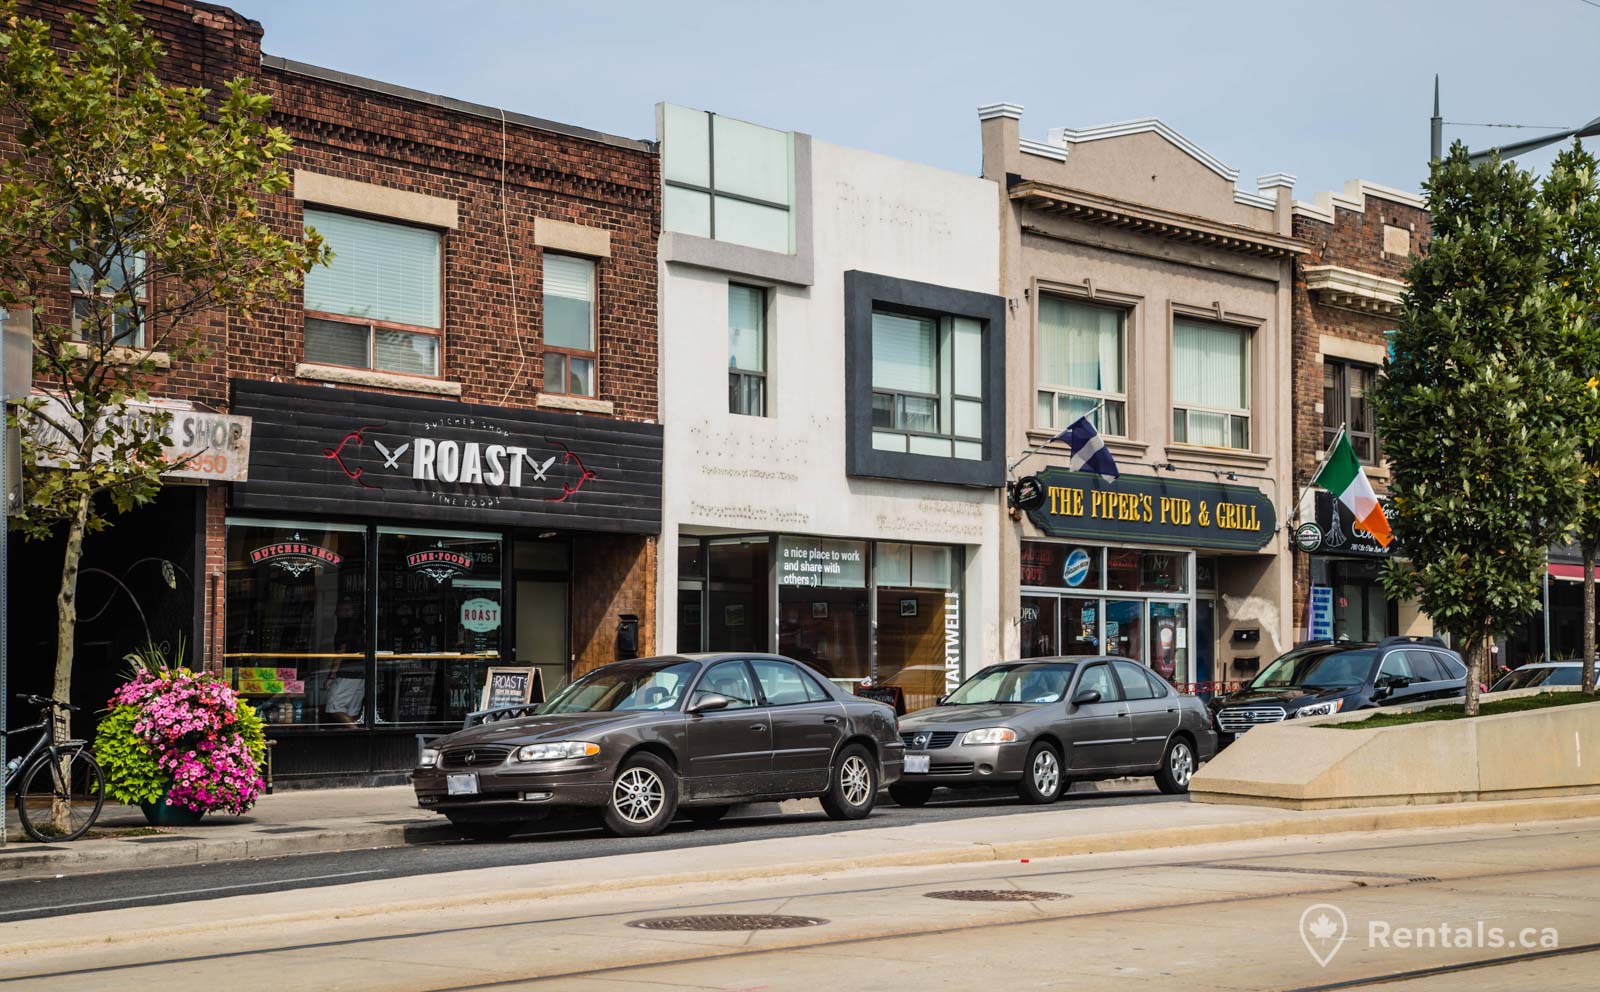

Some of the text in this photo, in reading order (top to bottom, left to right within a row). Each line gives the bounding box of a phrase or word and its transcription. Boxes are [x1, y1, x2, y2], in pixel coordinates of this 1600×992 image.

[182, 417, 243, 450] SHOP
[412, 437, 527, 488] ROAST
[432, 492, 501, 507] FINE FOODS
[1048, 486, 1084, 517] THE
[1091, 489, 1153, 523] PIPER'S
[1160, 496, 1192, 526] PUB
[1198, 501, 1210, 527] &
[1216, 502, 1261, 531] GRILL
[253, 544, 307, 561] BUTCHER
[311, 547, 341, 564] SHOP
[409, 552, 434, 565] FINE
[438, 552, 471, 567] FOODS
[476, 553, 493, 563] 786
[784, 548, 860, 562] a nice place to work
[784, 561, 840, 574] and share with
[784, 574, 809, 585] others
[464, 609, 497, 621] ROAST
[495, 675, 524, 690] ROAST
